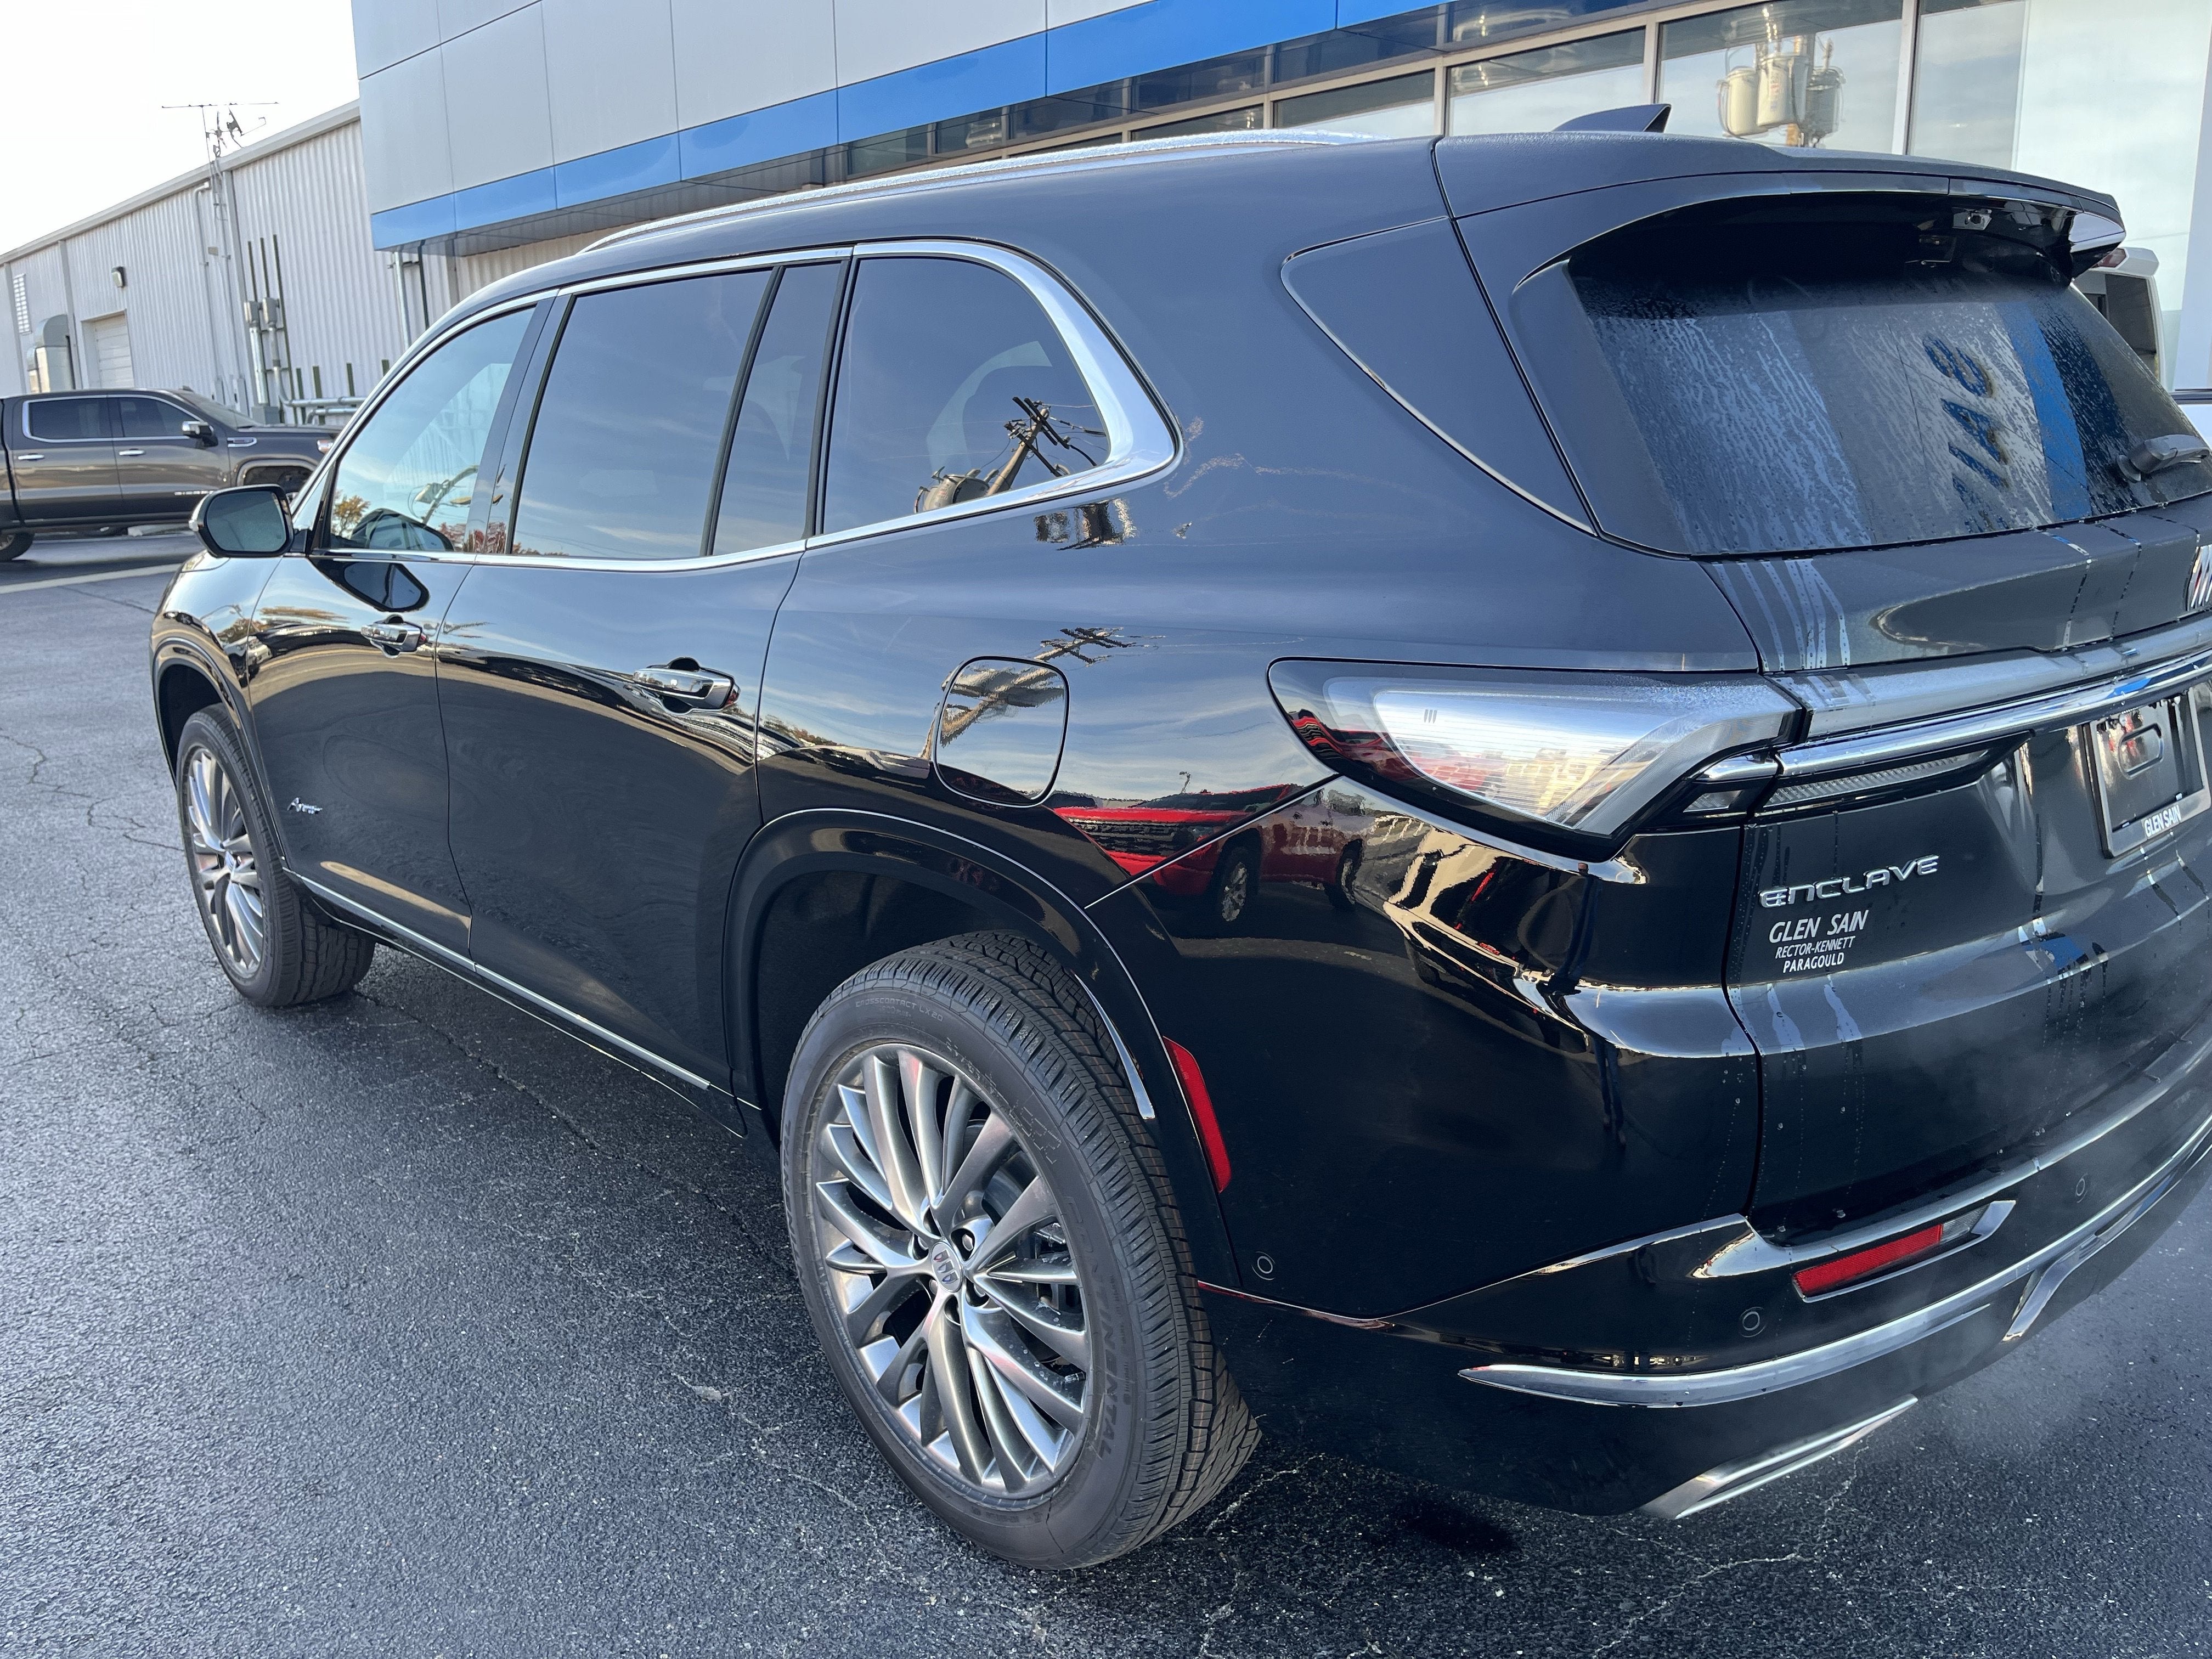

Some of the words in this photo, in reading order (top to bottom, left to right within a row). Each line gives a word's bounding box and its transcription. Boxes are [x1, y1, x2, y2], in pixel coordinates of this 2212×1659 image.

[2144, 813, 2164, 837] GLEN
[2163, 804, 2182, 827] SAIN
[1759, 855, 1940, 908] ENCLAVE
[1769, 917, 1821, 944] GLEN
[1827, 910, 1869, 935] SAIN
[1775, 935, 1856, 959] RECTOR-KENNETT
[1782, 952, 1844, 973] PARAGOULD
